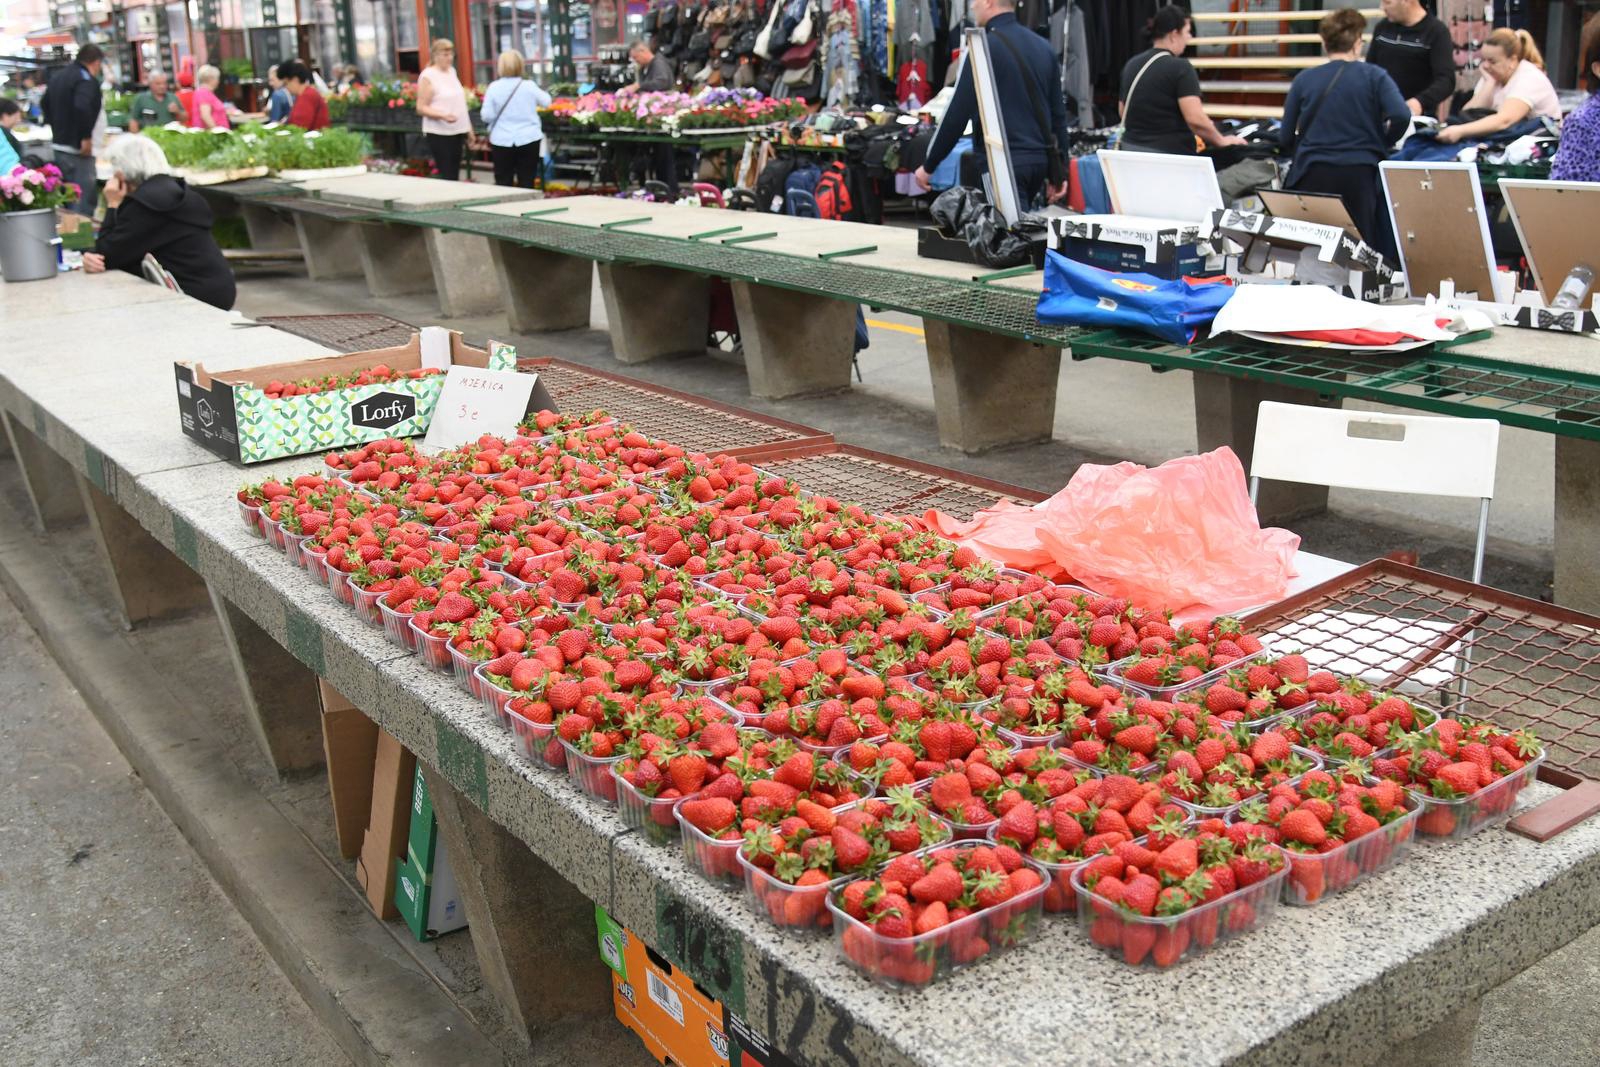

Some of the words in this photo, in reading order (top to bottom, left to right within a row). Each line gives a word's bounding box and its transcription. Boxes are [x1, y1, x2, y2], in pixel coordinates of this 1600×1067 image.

[361, 400, 407, 421] Lorfy
[458, 404, 467, 418] 3
[414, 779, 424, 815] BEEF
